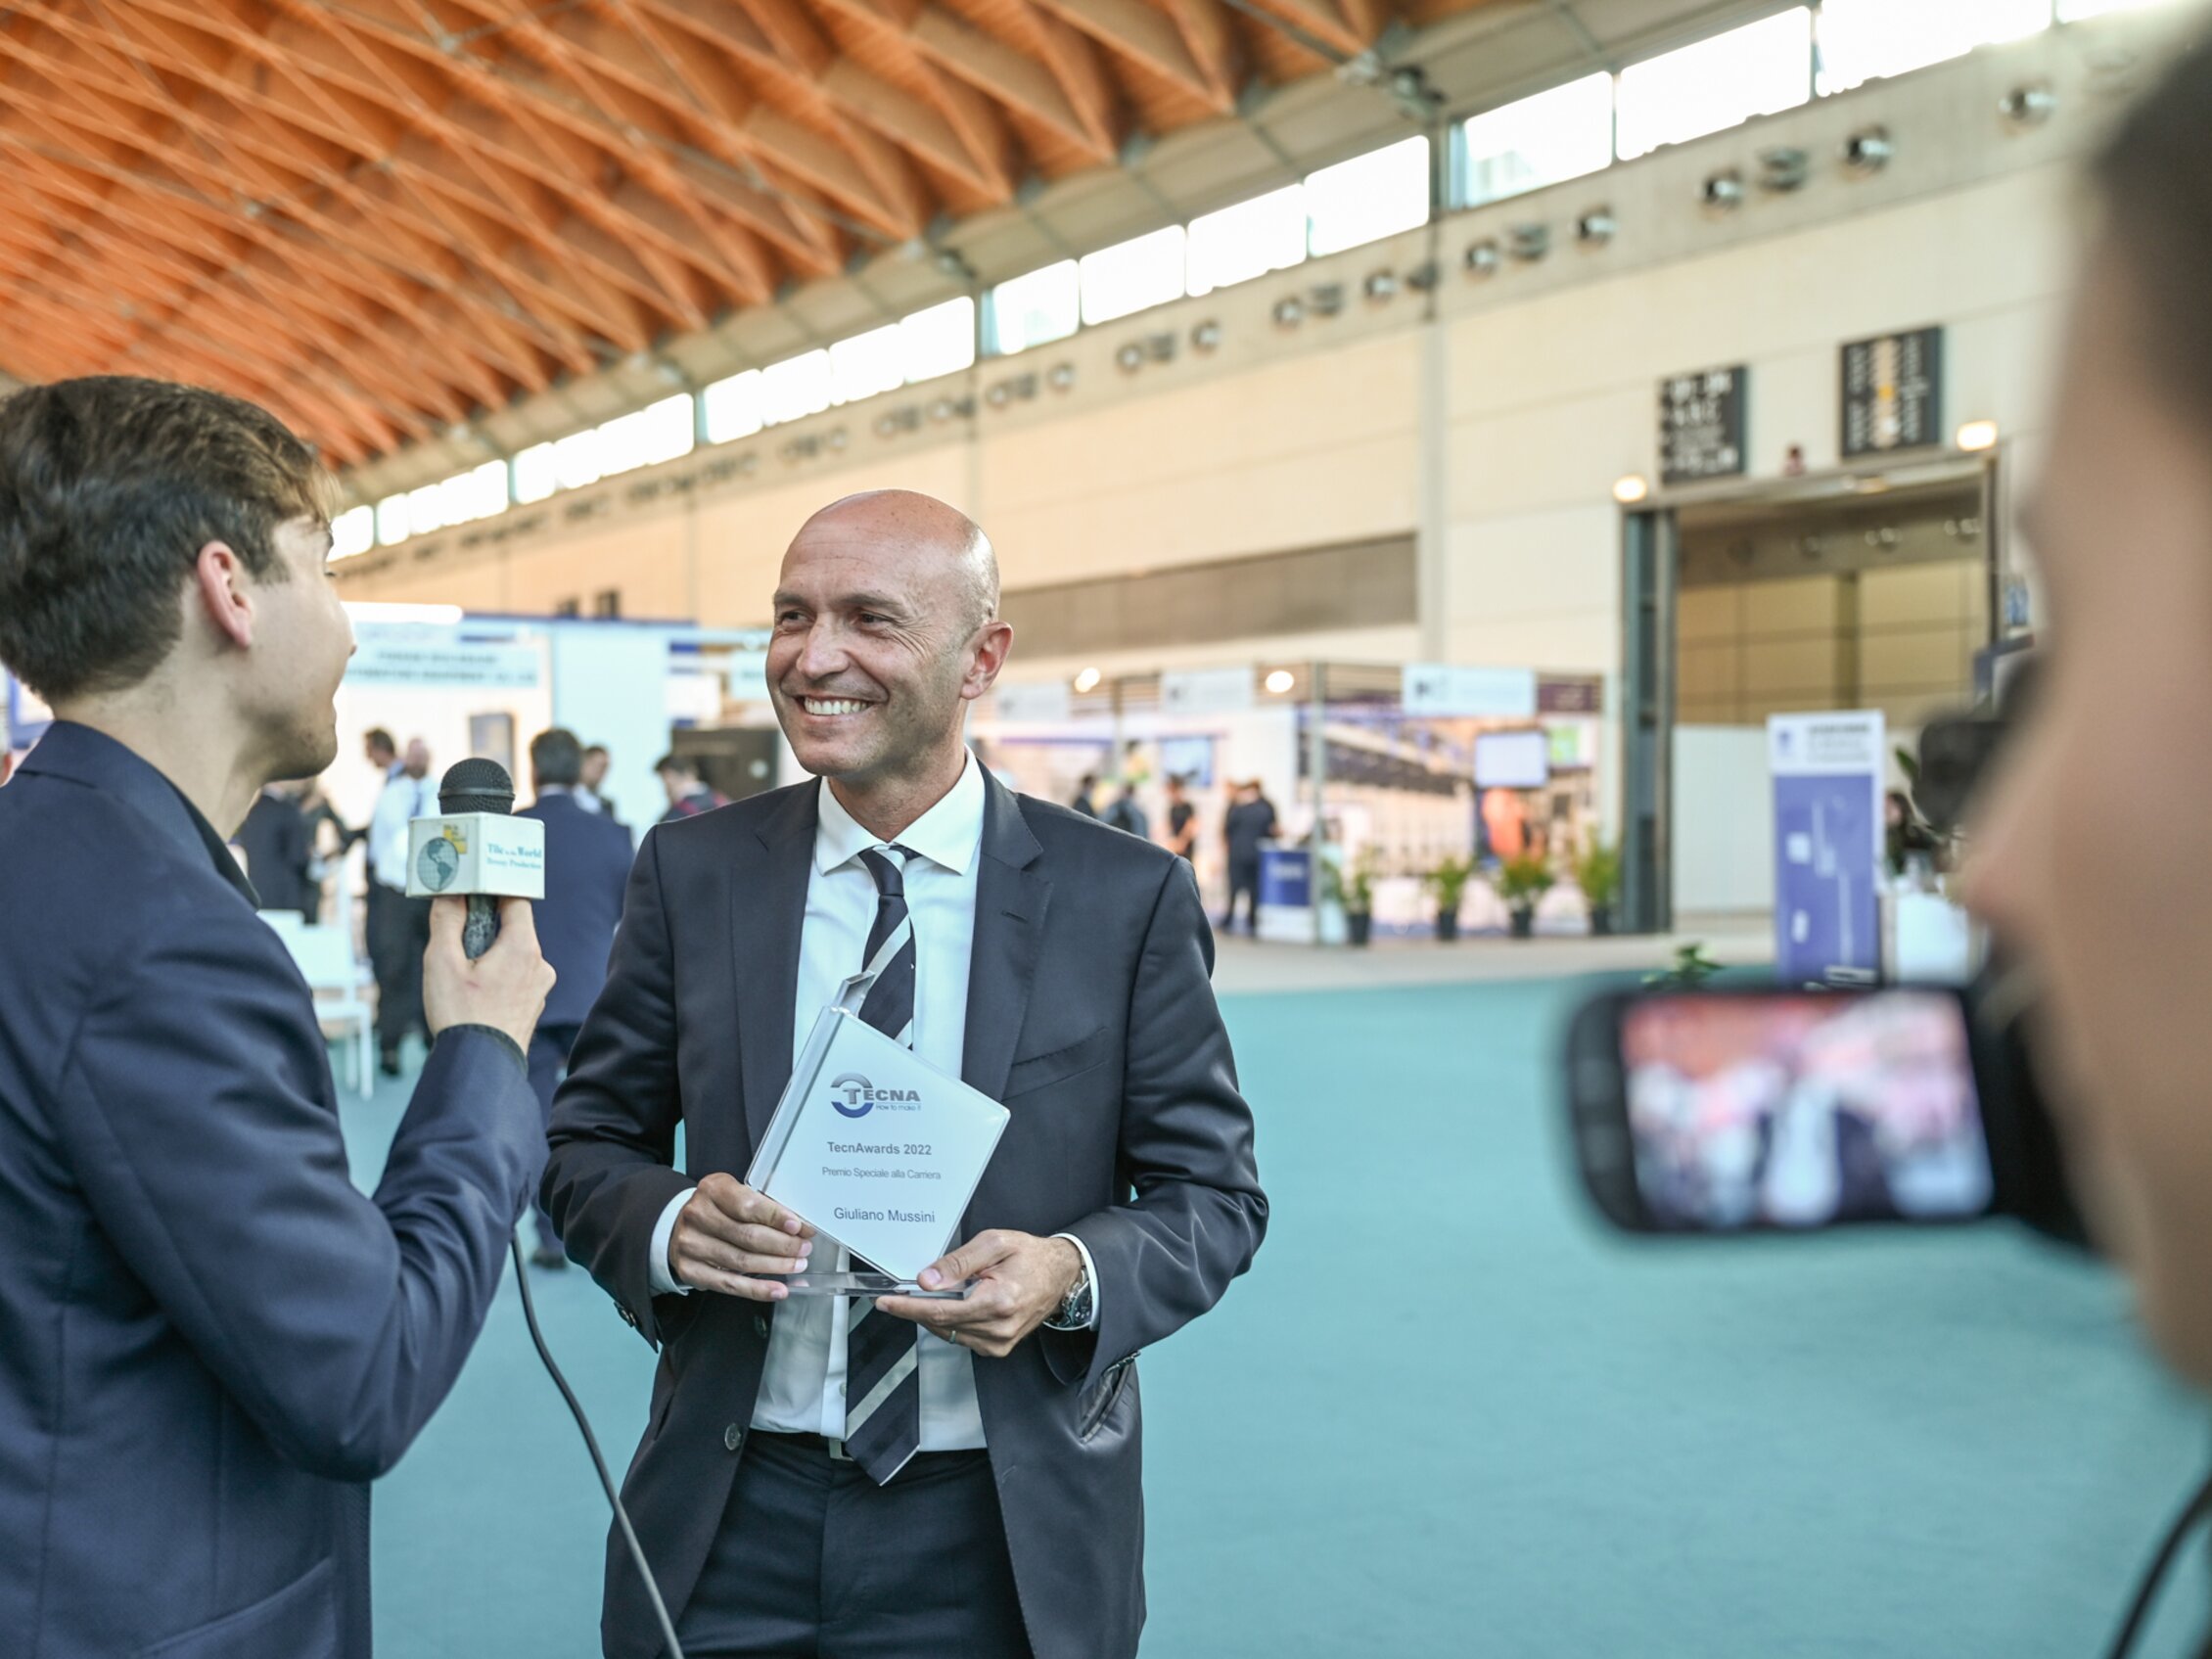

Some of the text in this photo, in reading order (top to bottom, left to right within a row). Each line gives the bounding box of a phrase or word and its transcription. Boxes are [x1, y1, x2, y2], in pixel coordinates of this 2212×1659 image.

[487, 843, 542, 858] Tile World
[843, 1088, 921, 1105] TECNA
[827, 1141, 932, 1156] TecnAwards 2022
[822, 1166, 853, 1177] Premio
[853, 1167, 890, 1179] Speciale
[891, 1169, 906, 1179] alla
[834, 1206, 936, 1223] Giuliano Mussini
